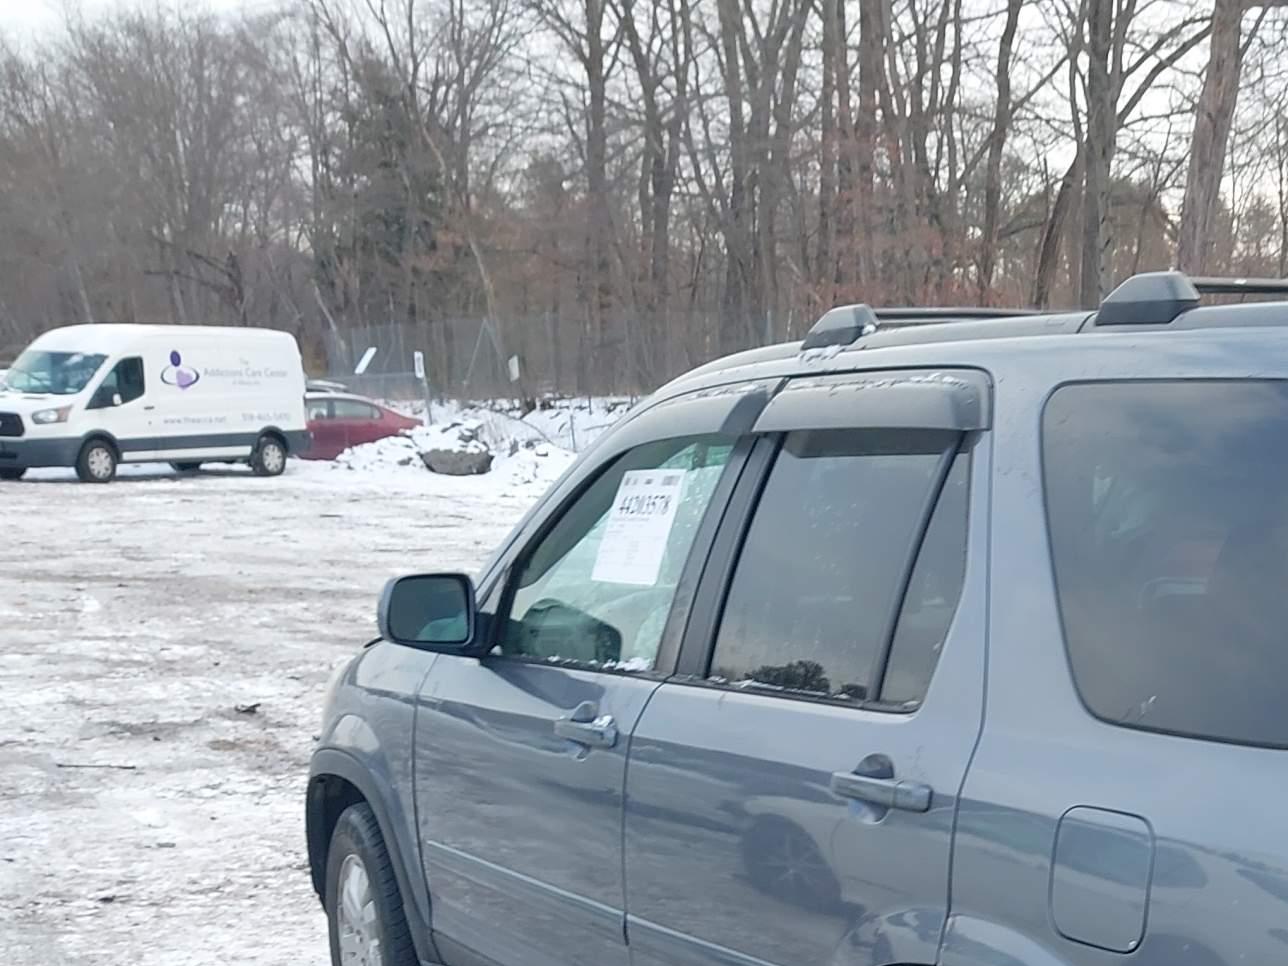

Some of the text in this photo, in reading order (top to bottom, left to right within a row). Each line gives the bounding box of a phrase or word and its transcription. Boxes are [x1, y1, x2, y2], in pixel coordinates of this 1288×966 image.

[203, 367, 287, 377] Addictions Care Center
[619, 494, 672, 515] 44203578
